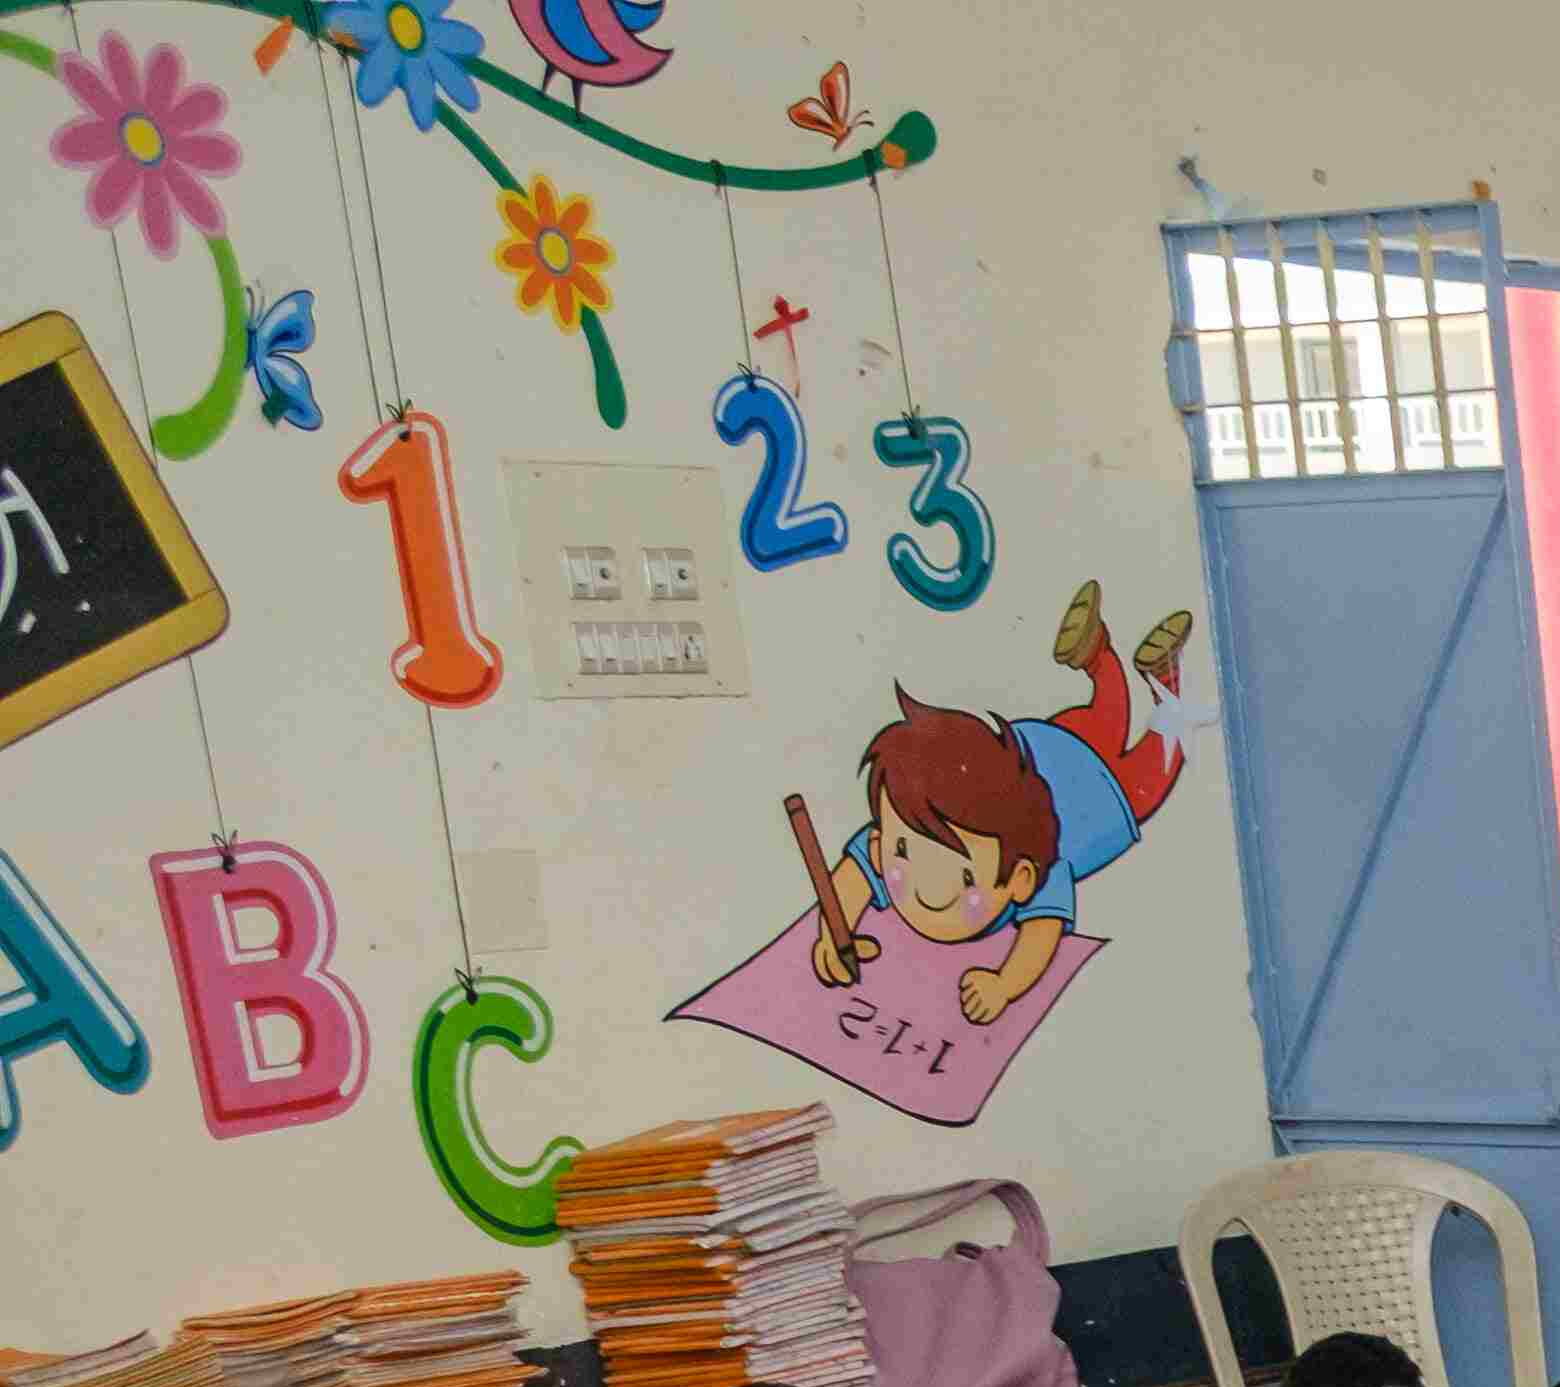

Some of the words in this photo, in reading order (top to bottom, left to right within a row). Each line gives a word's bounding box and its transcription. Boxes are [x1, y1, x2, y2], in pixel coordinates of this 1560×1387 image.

[338, 411, 503, 708] 1
[714, 373, 847, 572] 2
[873, 416, 996, 612] 3
[149, 840, 371, 1140] B
[413, 975, 588, 1247] C
